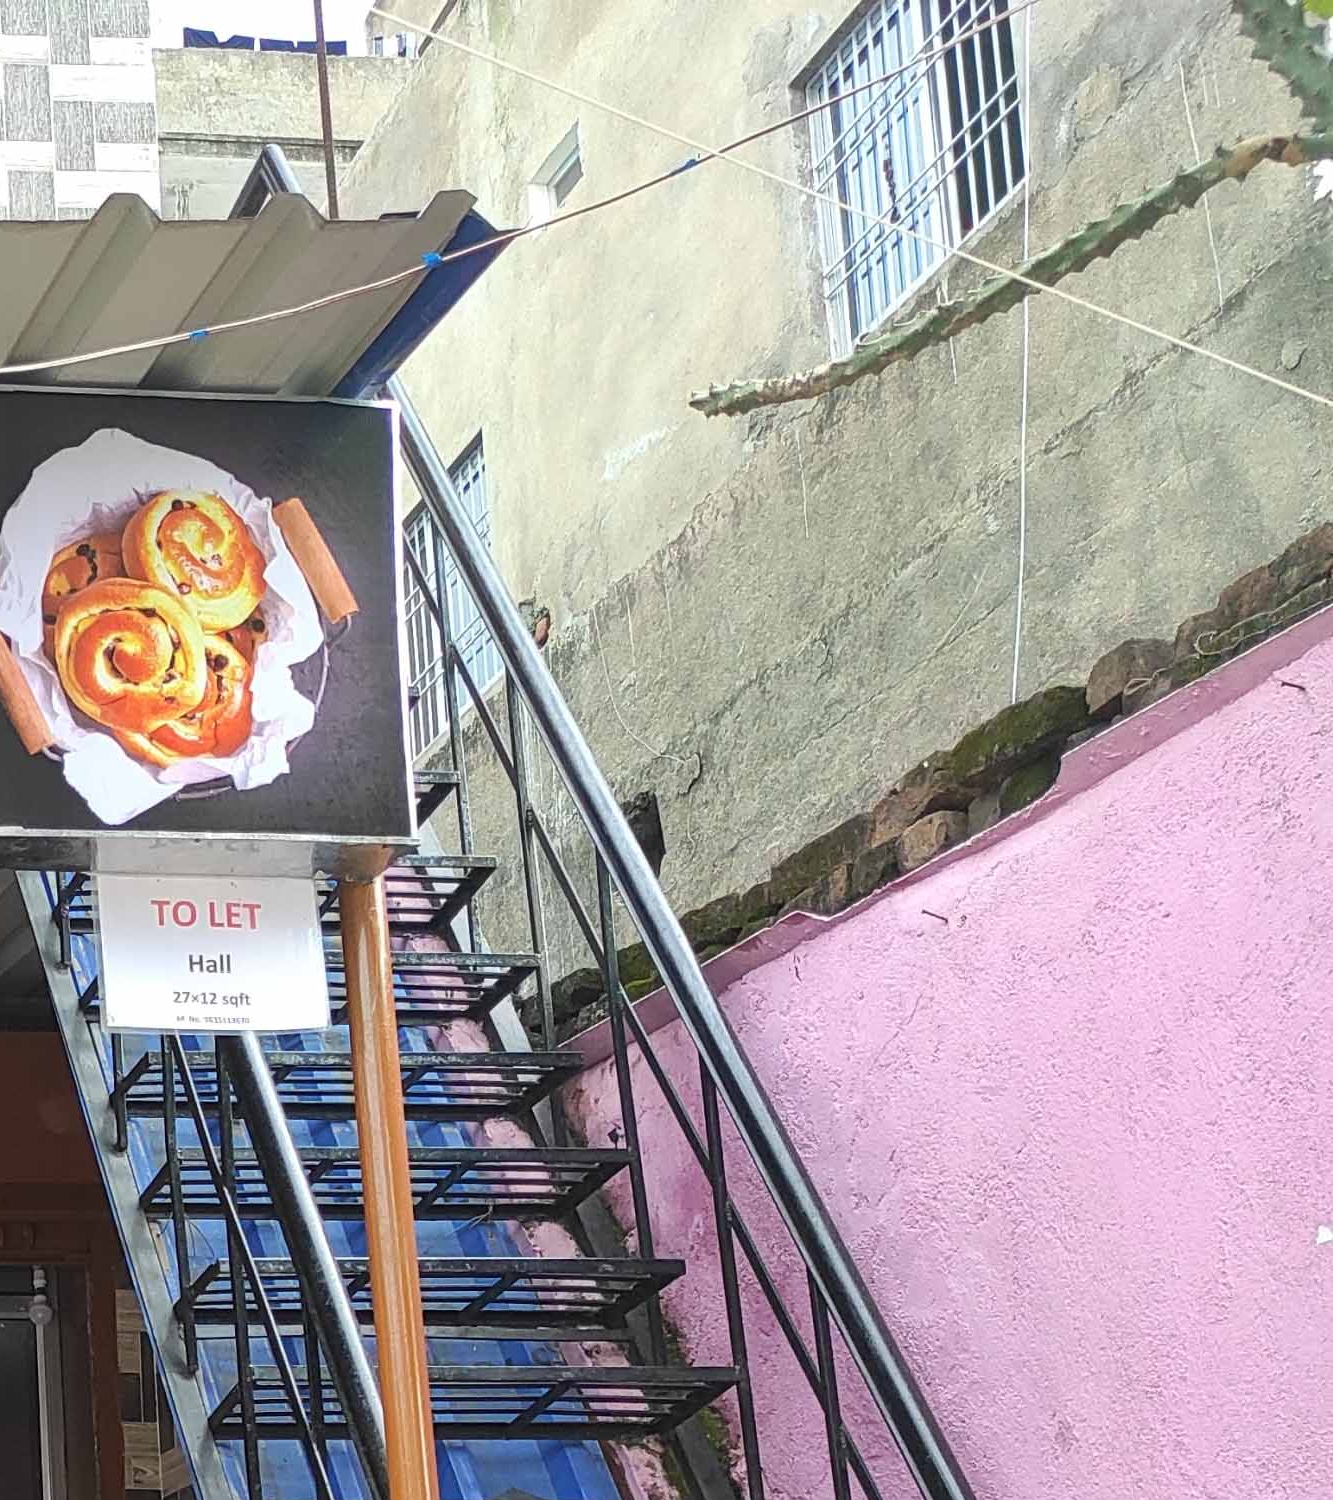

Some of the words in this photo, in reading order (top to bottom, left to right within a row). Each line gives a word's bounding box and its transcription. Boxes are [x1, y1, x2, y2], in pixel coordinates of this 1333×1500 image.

[150, 900, 197, 927] TO
[209, 902, 261, 929] LET
[188, 954, 231, 974] Hall
[221, 992, 251, 1007] sqft
